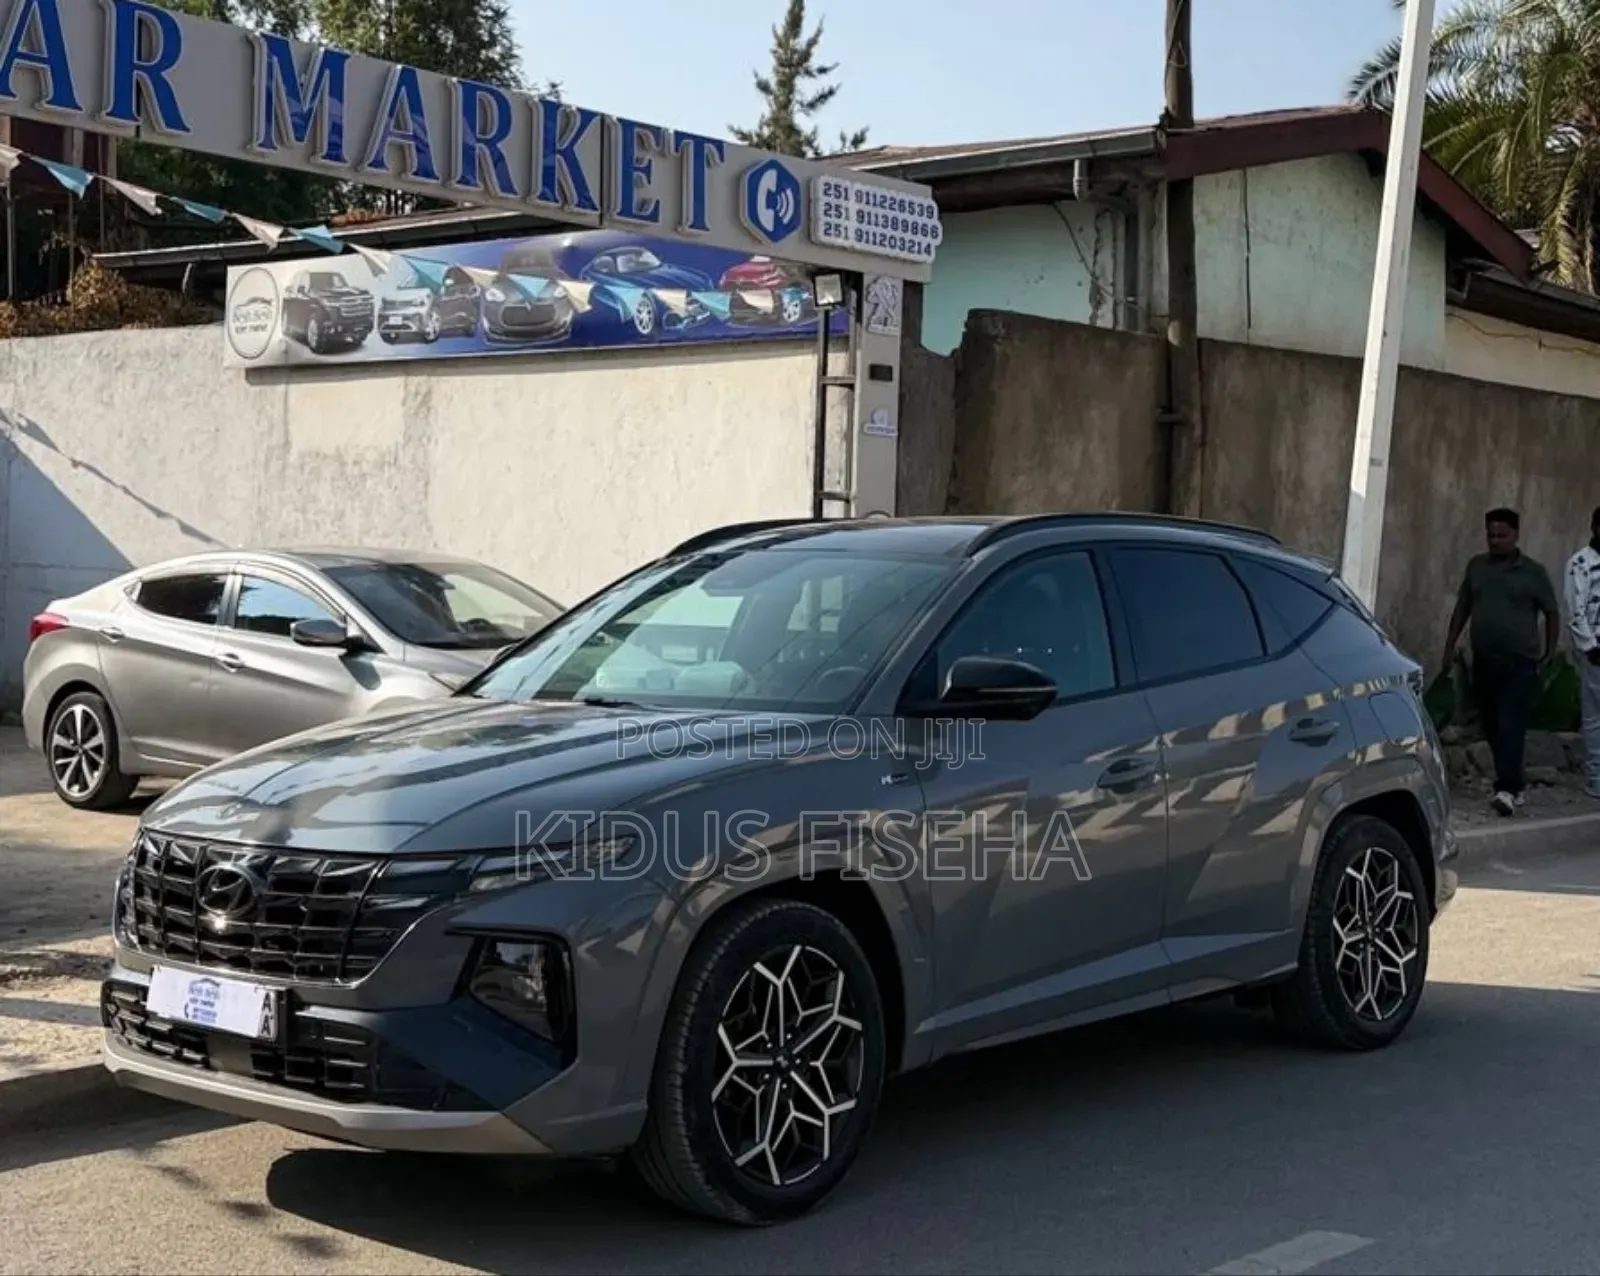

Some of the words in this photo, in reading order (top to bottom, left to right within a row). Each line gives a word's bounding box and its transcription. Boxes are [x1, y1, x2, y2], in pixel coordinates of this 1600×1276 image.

[256, 31, 724, 232] MARKET
[823, 182, 849, 200] 251
[855, 189, 935, 219] 911226539
[823, 202, 849, 220] 251
[856, 209, 939, 238] 911389866
[823, 222, 849, 240] 251
[855, 228, 932, 256] 911203214
